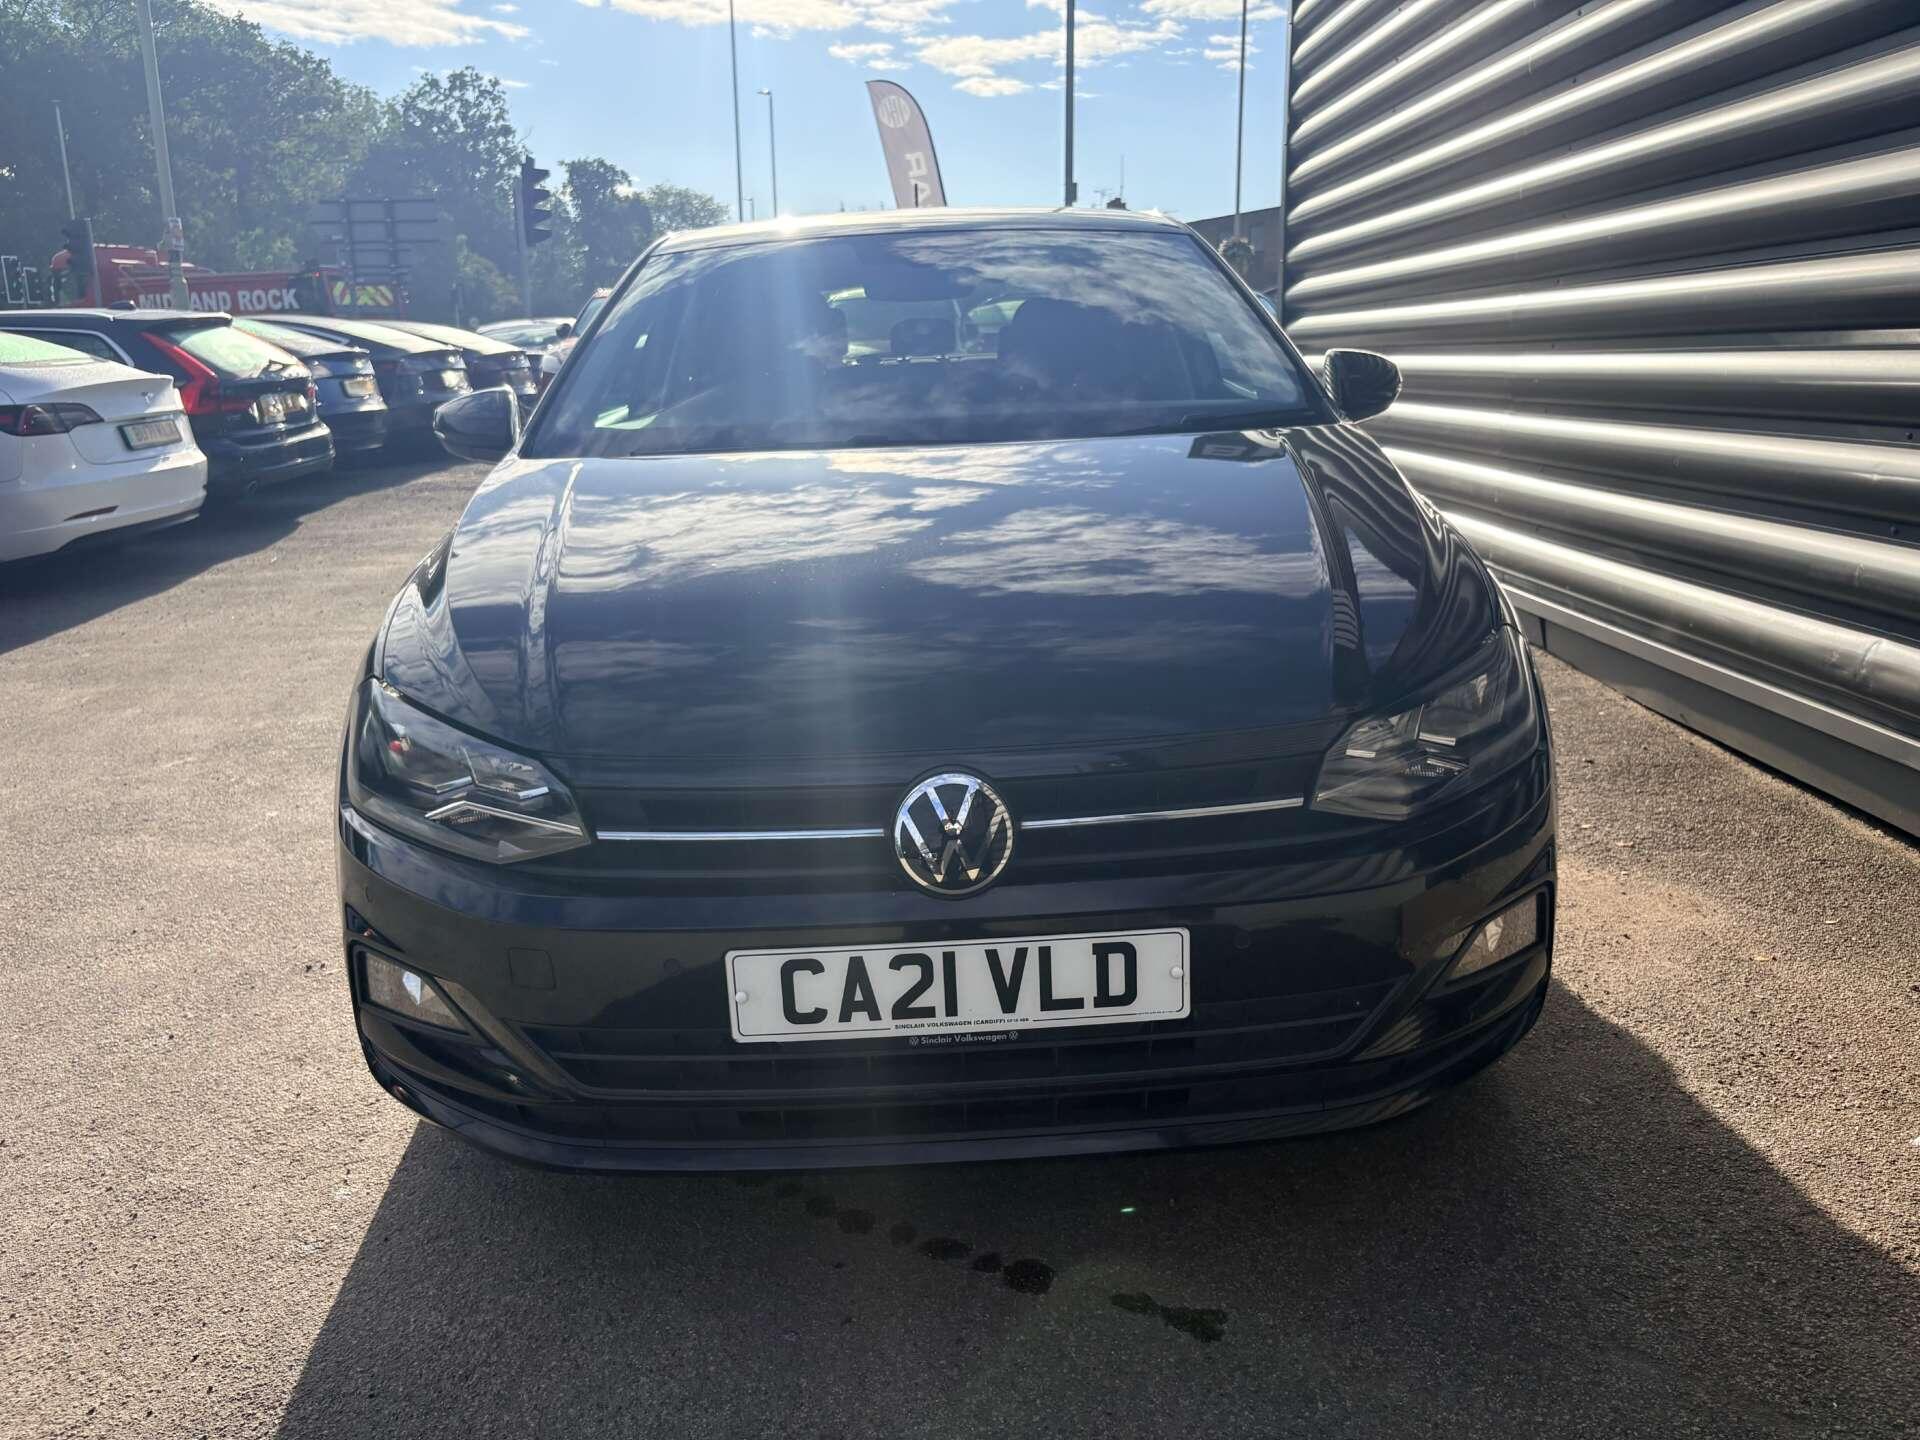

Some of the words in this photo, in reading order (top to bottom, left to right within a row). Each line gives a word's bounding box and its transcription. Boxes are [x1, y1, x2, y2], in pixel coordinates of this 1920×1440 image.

[138, 291, 231, 311] MIDAND
[238, 289, 299, 311] ROCK
[780, 951, 958, 1025] CA21
[984, 942, 1138, 1015] VLD
[927, 1020, 972, 1028] VOLKSWAGEN
[921, 1035, 953, 1045] Sinclair
[954, 1032, 1007, 1043] Volkswagen
